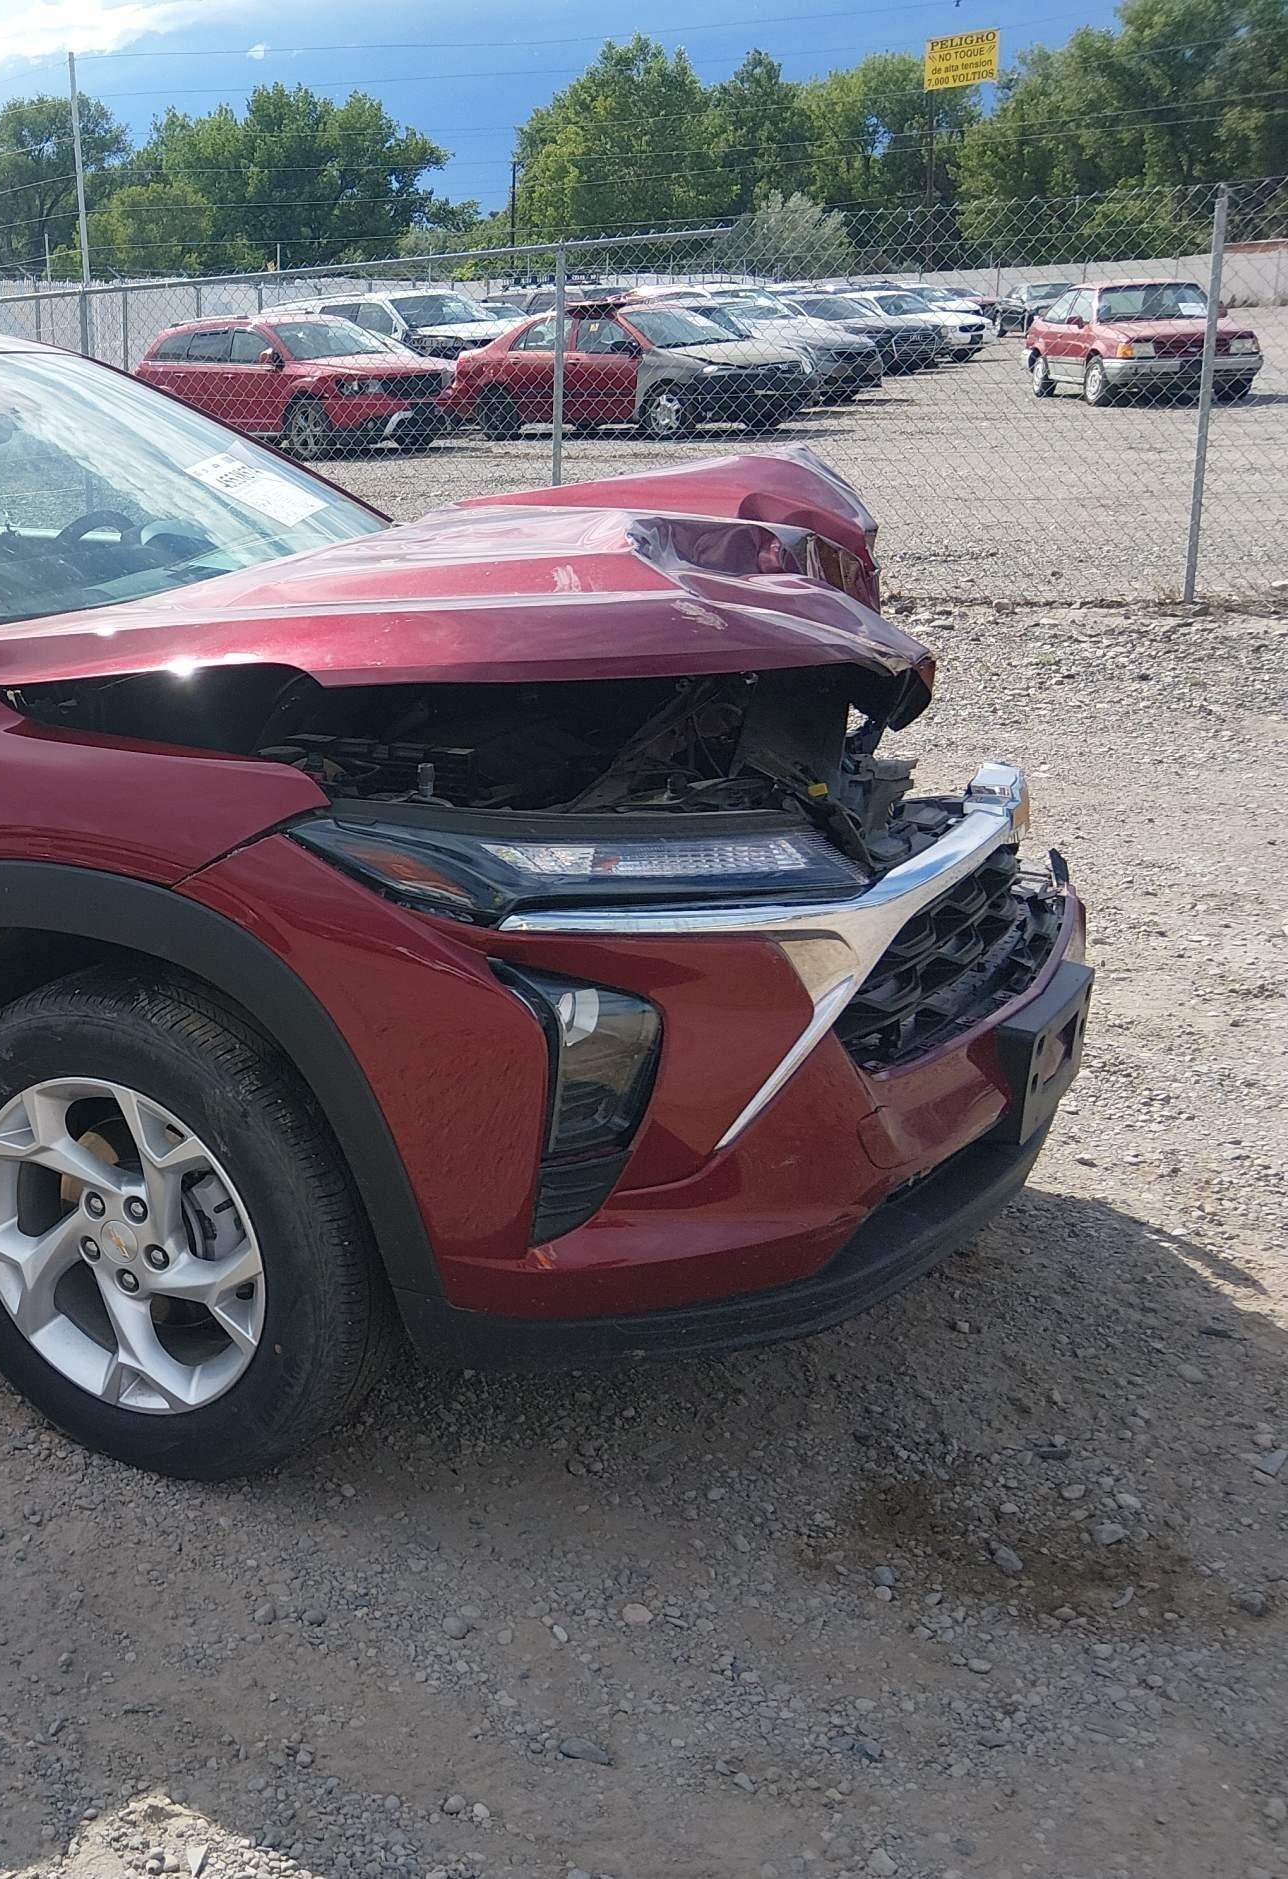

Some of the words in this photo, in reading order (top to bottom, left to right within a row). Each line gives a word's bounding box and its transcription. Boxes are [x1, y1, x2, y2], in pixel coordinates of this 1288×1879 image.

[930, 31, 996, 51] PELIGRO
[938, 52, 951, 62] NO
[954, 46, 985, 61] TOQUE
[931, 67, 942, 75] de
[944, 64, 959, 73] alta
[951, 68, 994, 84] VOLTIOS
